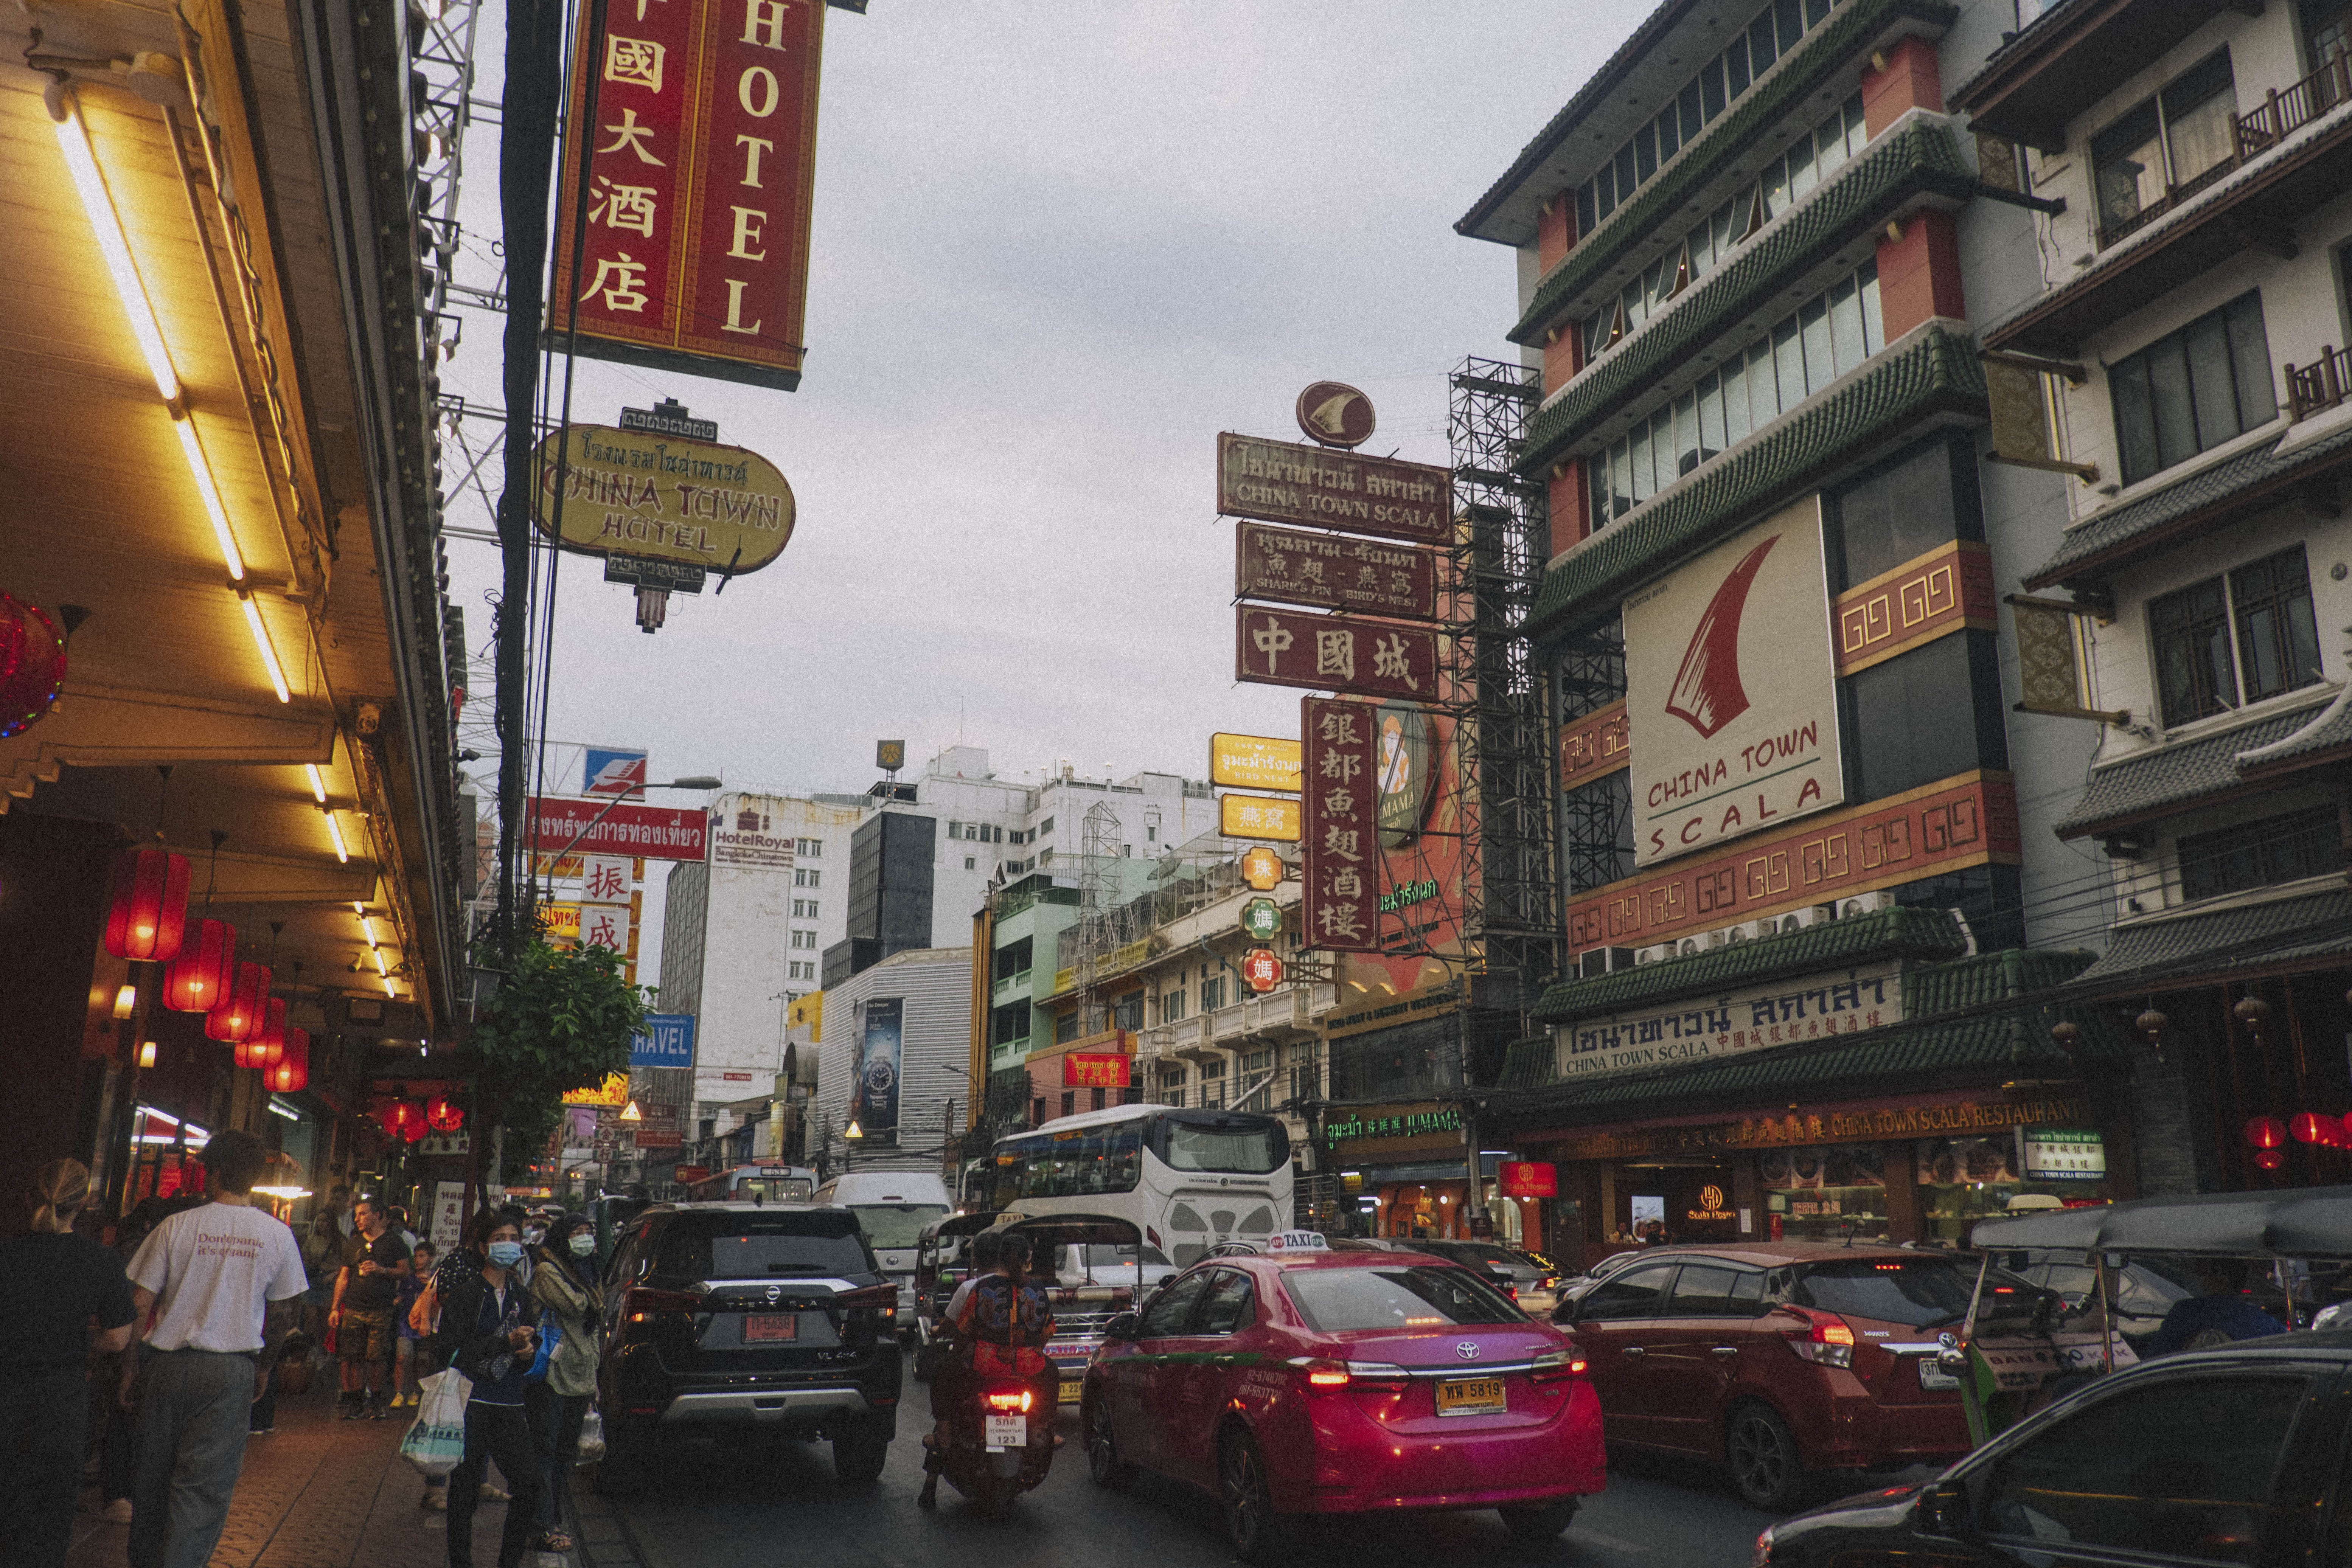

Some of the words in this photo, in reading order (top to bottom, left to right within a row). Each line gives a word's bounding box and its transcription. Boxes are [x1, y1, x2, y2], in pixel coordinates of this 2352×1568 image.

[579, 0, 667, 313] 國大酒店
[721, 0, 789, 335] HOTEL
[544, 464, 663, 515] CHINA
[675, 481, 781, 530] TOWN
[1236, 483, 1300, 509] CHINA
[1307, 494, 1369, 518] TOWN
[1374, 504, 1439, 529] SCALA
[602, 512, 717, 553] HOTEL
[1256, 578, 1308, 593] SHARK'S
[1312, 585, 1332, 597] FIN
[1345, 590, 1386, 603] BIRD'S
[1388, 595, 1418, 608] NEST
[1253, 616, 1418, 691] 中國城
[1235, 772, 1259, 780] BIRD
[1648, 759, 1727, 808] CHINA
[1741, 720, 1818, 773] TOWN
[1380, 792, 1414, 818] MAMA
[1650, 778, 1821, 856] SCALA
[1317, 712, 1367, 941] 銀都魚翅酒樓
[586, 863, 629, 899] 振
[585, 915, 620, 952] 成
[1571, 996, 1732, 1054] ไชน่าทาวน์
[1752, 970, 1887, 1028] สกาล่า
[635, 1027, 687, 1055] RAVEL
[1566, 1054, 1607, 1074] CHINA
[1611, 1046, 1653, 1067] TOWN
[1658, 1040, 1709, 1061] SCALA
[1407, 1110, 1461, 1137] JUMAMA
[1831, 1115, 1873, 1136] CHINA
[1875, 1110, 1917, 1134] TOWN
[1920, 1105, 1970, 1131] SCALA
[1974, 1099, 2080, 1128] RESTAURANT
[197, 1245, 216, 1256] it's
[231, 1236, 265, 1249] panic
[1284, 1234, 1311, 1247] TAXI
[1470, 1382, 1500, 1397] 5819
